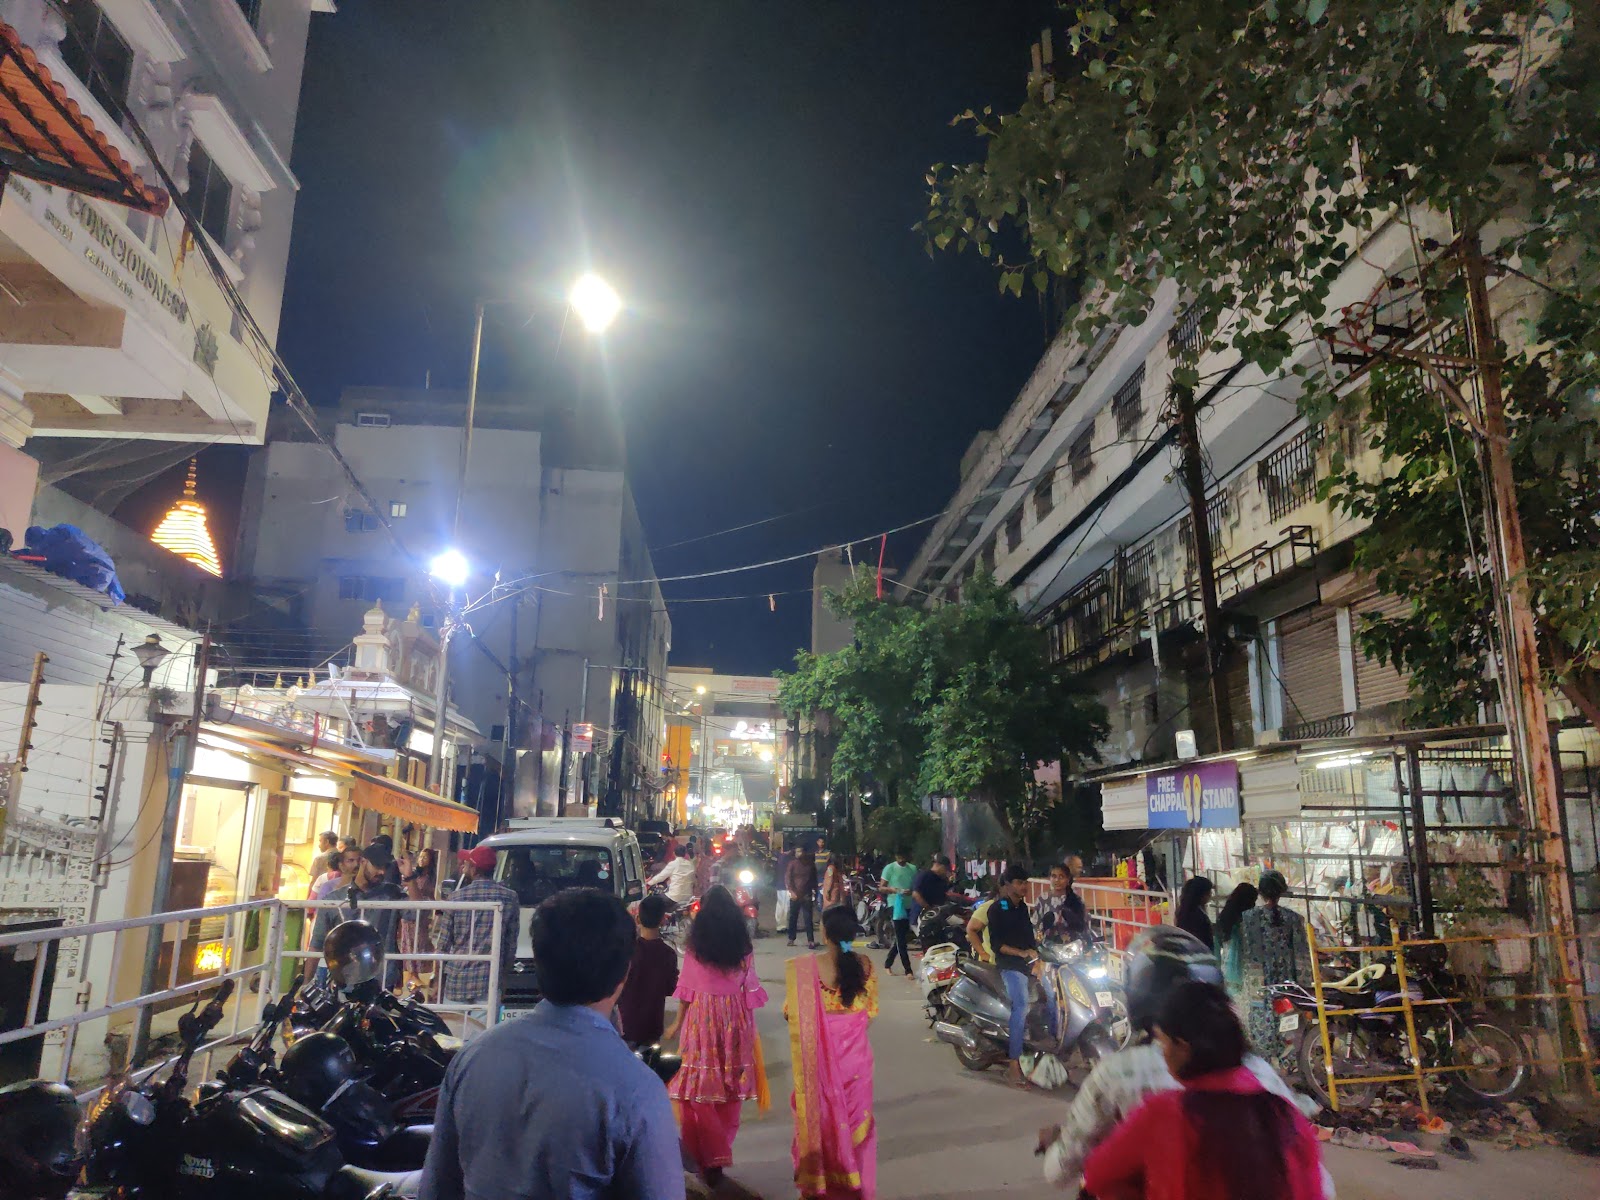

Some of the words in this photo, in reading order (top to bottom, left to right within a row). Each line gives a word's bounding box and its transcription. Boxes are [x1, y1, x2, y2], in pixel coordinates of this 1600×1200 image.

[66, 191, 189, 323] CONSCIOUSNESS
[1157, 776, 1176, 793] FREE
[1150, 792, 1188, 813] CHAPPAL
[1202, 787, 1235, 810] STAND
